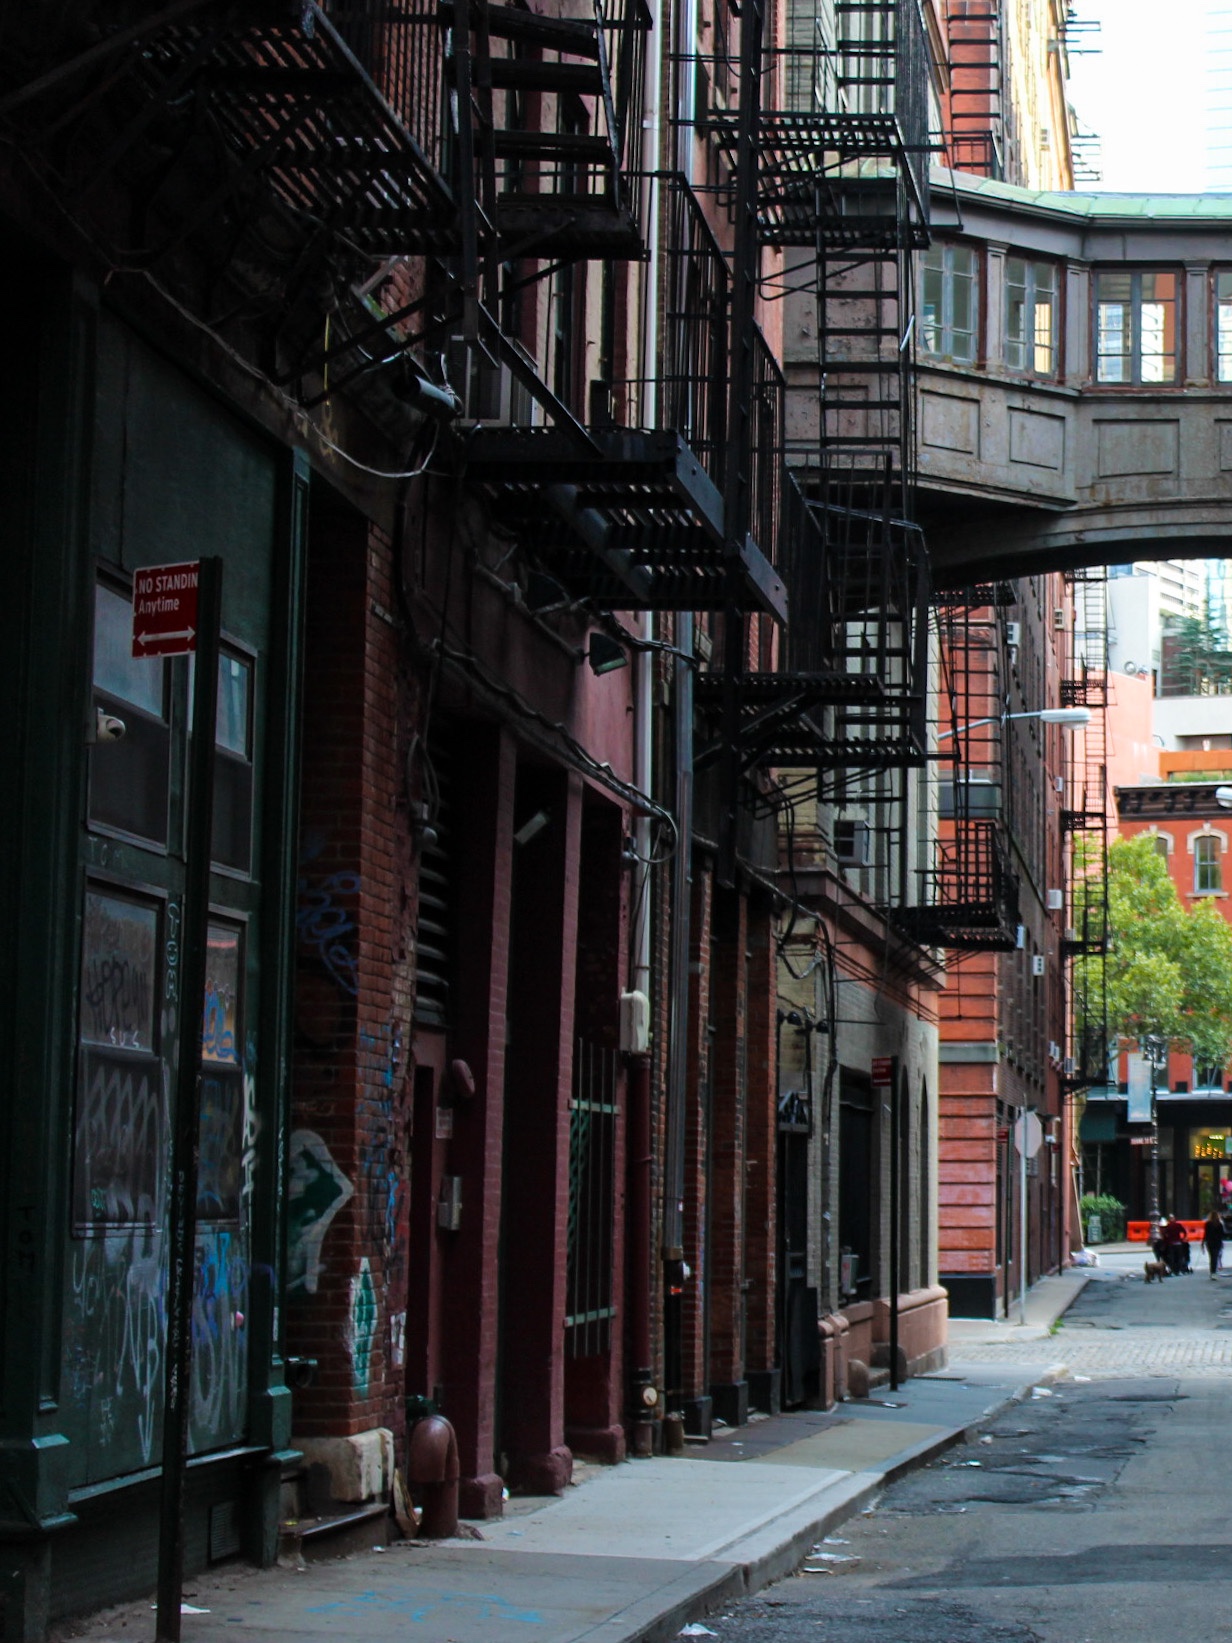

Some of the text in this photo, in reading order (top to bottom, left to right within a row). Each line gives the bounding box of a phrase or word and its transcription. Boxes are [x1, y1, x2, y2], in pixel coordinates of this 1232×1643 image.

[138, 572, 199, 594] NO STANDIN
[138, 596, 180, 617] Anytime
